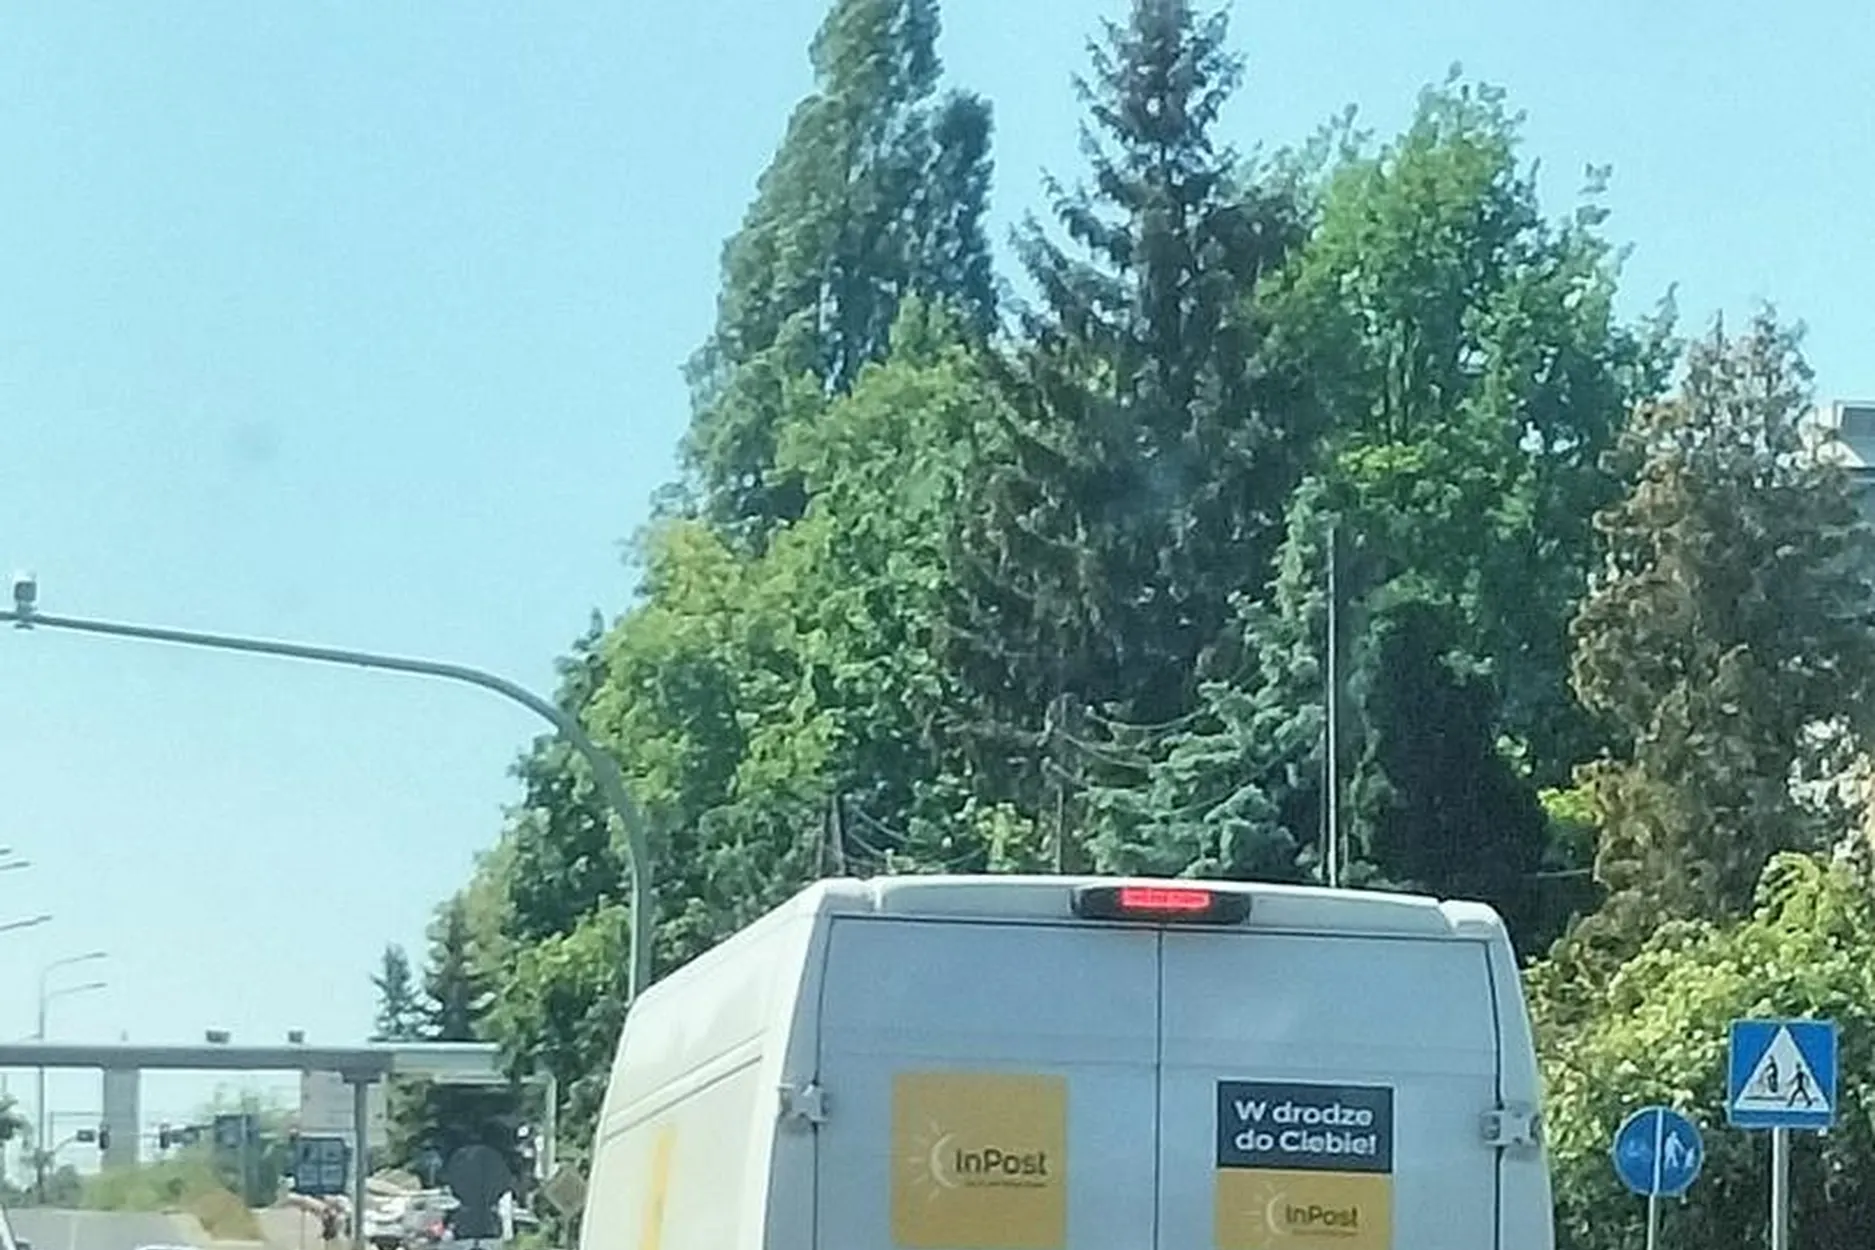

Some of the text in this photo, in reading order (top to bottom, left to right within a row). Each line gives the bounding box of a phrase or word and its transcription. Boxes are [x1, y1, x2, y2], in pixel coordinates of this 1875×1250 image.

[1234, 1100, 1374, 1127] W drodze
[1235, 1128, 1377, 1155] do Ciebie!
[955, 1148, 1047, 1175] InPost
[1285, 1204, 1358, 1227] InPost
